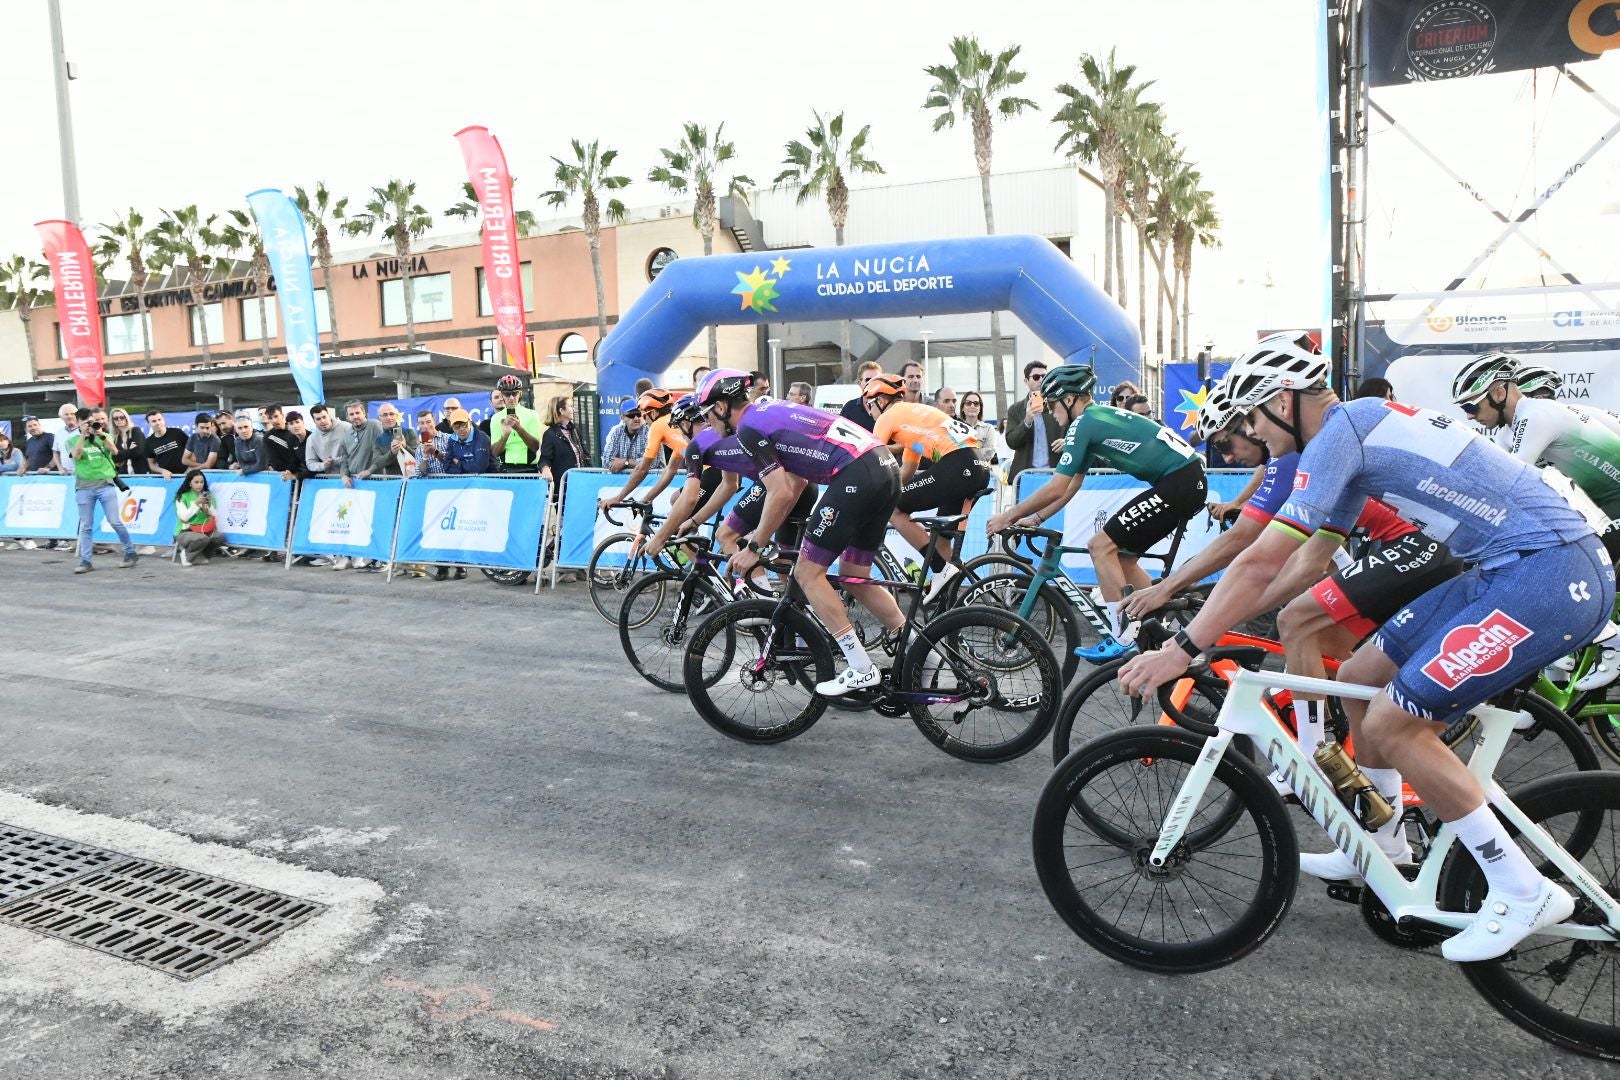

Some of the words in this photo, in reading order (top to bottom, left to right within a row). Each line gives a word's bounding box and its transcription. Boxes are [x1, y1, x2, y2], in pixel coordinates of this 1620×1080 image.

[1415, 25, 1489, 49] CRITERIUM
[352, 263, 369, 280] LA
[376, 255, 429, 277] NUIA
[816, 261, 840, 280] LA
[816, 283, 865, 297] CIUDAD
[867, 279, 890, 294] DEL
[893, 275, 954, 292] DEPORTE
[1245, 373, 1279, 401] CANYON
[1562, 372, 1595, 384] ITAT
[1556, 387, 1591, 399] ANA
[1513, 418, 1528, 454] SEGUROS
[1574, 449, 1601, 467] CAJA
[1117, 493, 1163, 526] KERN
[1415, 476, 1508, 527] deceuninck
[1126, 503, 1170, 531] PHARMA
[1368, 534, 1420, 569] ABTF
[1394, 542, 1438, 573] betão
[881, 550, 909, 584] ORB
[963, 578, 1019, 607] CADEX
[1053, 576, 1113, 637] GIANT
[1437, 624, 1513, 679] Alpecin
[1452, 664, 1476, 682] HAIR
[1476, 633, 1520, 665] BOOSTER
[1004, 692, 1043, 708] DEX
[1267, 738, 1372, 880] CANYON
